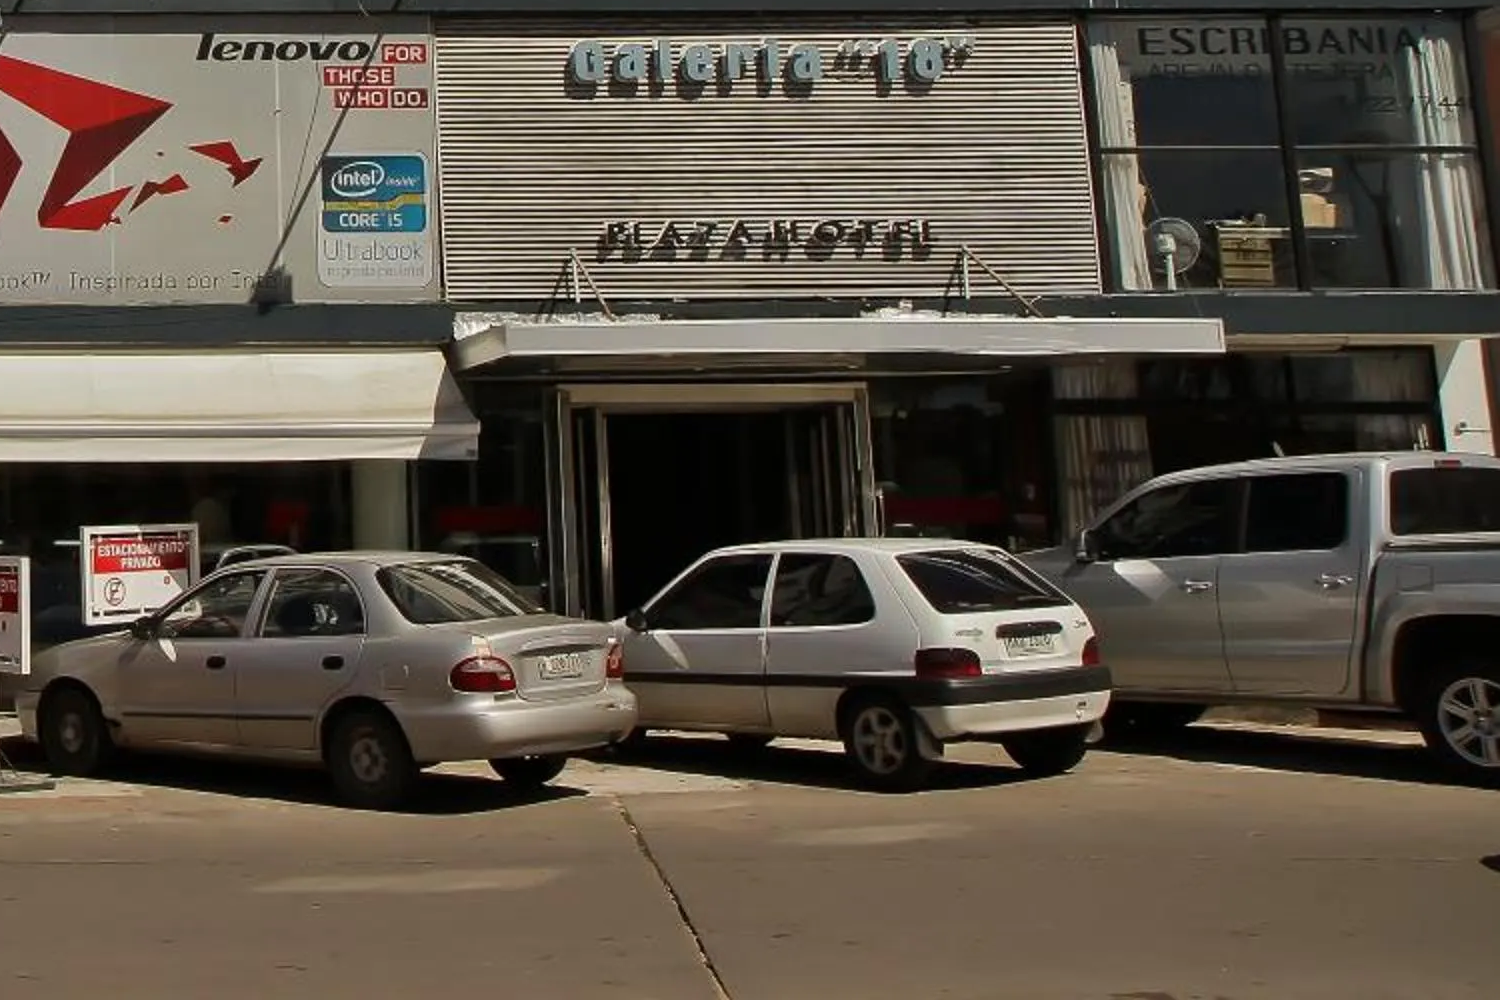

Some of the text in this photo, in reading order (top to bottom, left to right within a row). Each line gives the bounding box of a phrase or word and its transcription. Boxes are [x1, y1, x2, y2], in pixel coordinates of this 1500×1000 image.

[196, 33, 424, 62] lenovo FOR
[570, 36, 825, 83] Galeria
[325, 67, 393, 85] THOSE
[338, 90, 428, 107] WHO DO.
[338, 168, 377, 187] intel
[339, 212, 404, 228] CORE i5
[604, 219, 754, 247] PLAZA
[68, 270, 178, 292] Inspirada
